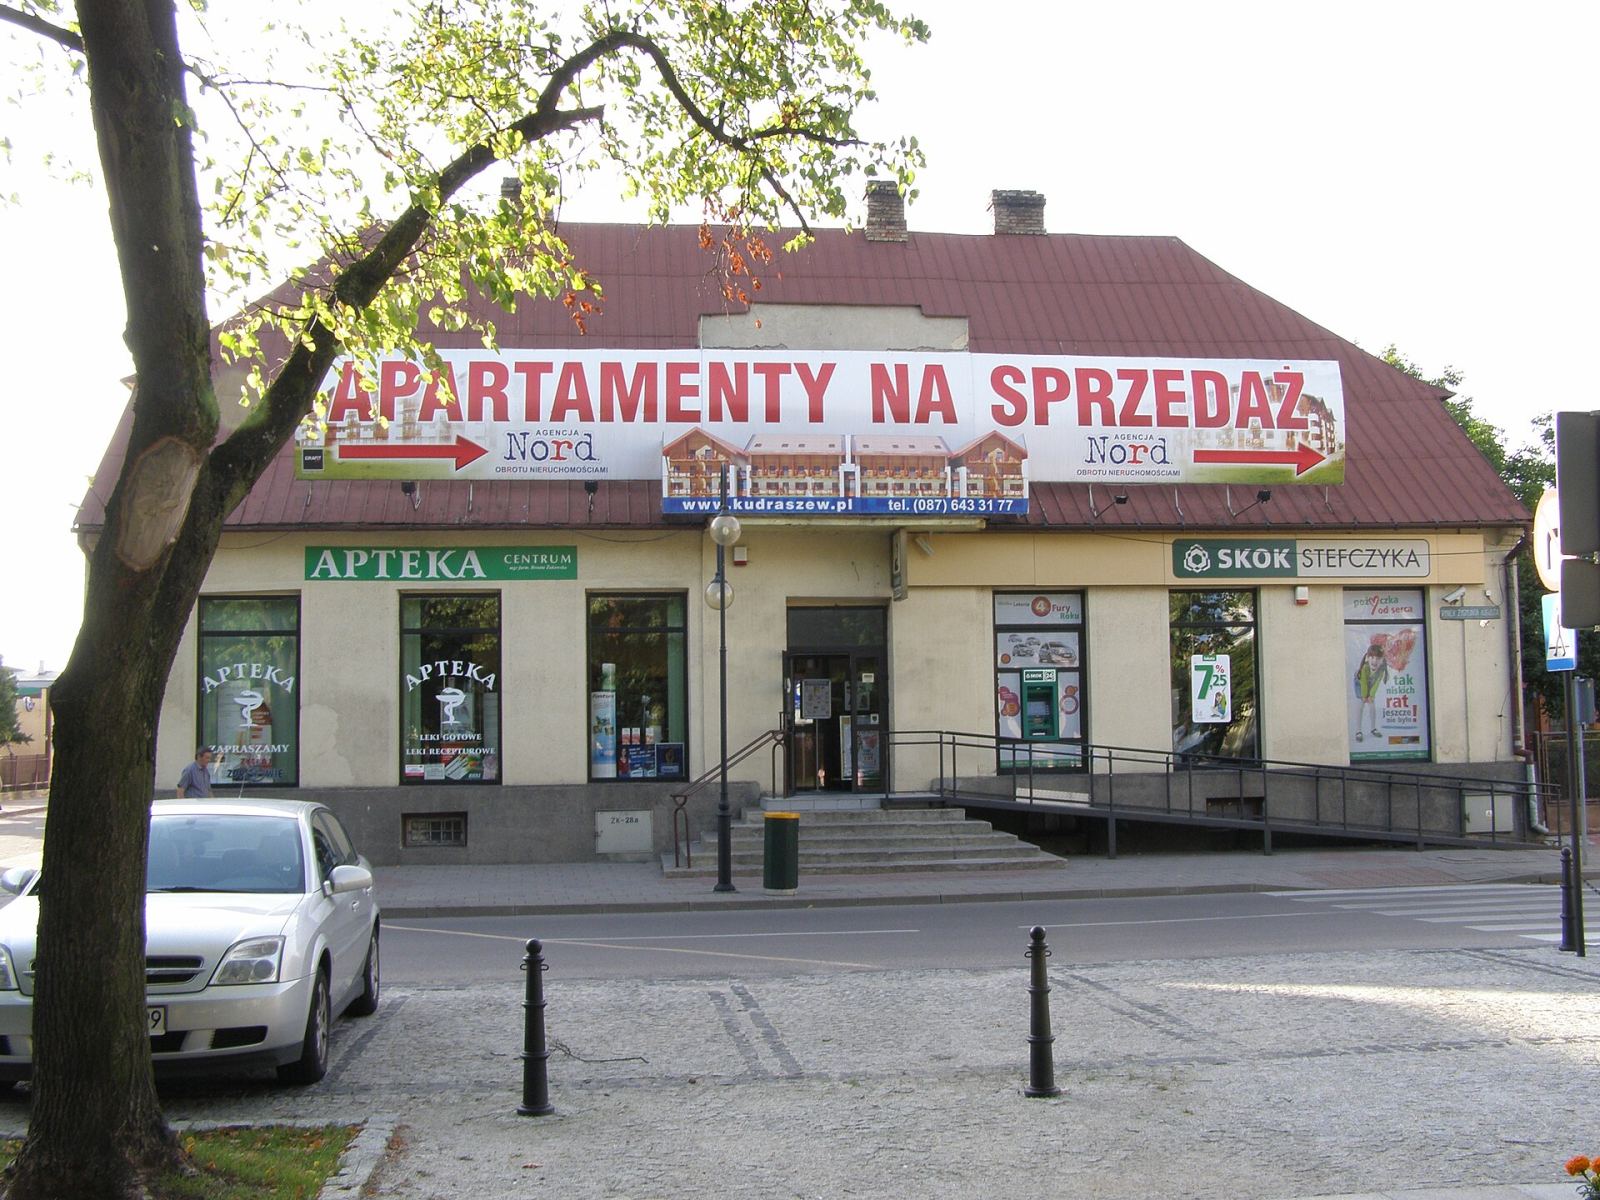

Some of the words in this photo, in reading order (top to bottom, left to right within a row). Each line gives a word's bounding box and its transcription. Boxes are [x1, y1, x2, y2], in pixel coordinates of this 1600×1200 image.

[328, 361, 837, 423] APARTAMENTY
[870, 363, 958, 424] NA
[990, 365, 1309, 430] SPRZEDAŻ
[529, 465, 609, 473] NIERUCHOMOŚCIAMI
[1108, 468, 1180, 476] NIERUCHOMOŚCIAMI
[682, 498, 853, 512] www.kudraszew.pl
[888, 499, 910, 511] tel.
[913, 499, 947, 513] (087)
[951, 499, 975, 511] 643
[978, 499, 993, 511] 31
[997, 500, 1013, 511] 77
[310, 549, 487, 578] APTEKA
[504, 554, 571, 564] CENTRUM
[1217, 547, 1291, 569] SKOK
[1302, 547, 1420, 568] STEFCZYKA
[1052, 604, 1071, 613] Fury
[1378, 605, 1389, 614] od
[202, 663, 295, 694] APTEKA
[406, 660, 496, 692] APTEKA
[1394, 674, 1414, 686] tak
[1386, 686, 1416, 695] niskich
[1386, 695, 1409, 708] rat
[1382, 707, 1412, 718] jeszcze
[420, 733, 440, 741] LEKI
[442, 733, 482, 741] GOTOWE
[208, 744, 290, 753] ZAPRASZAMY
[406, 747, 426, 755] LEKI
[429, 747, 496, 755] RECEPTUROWE
